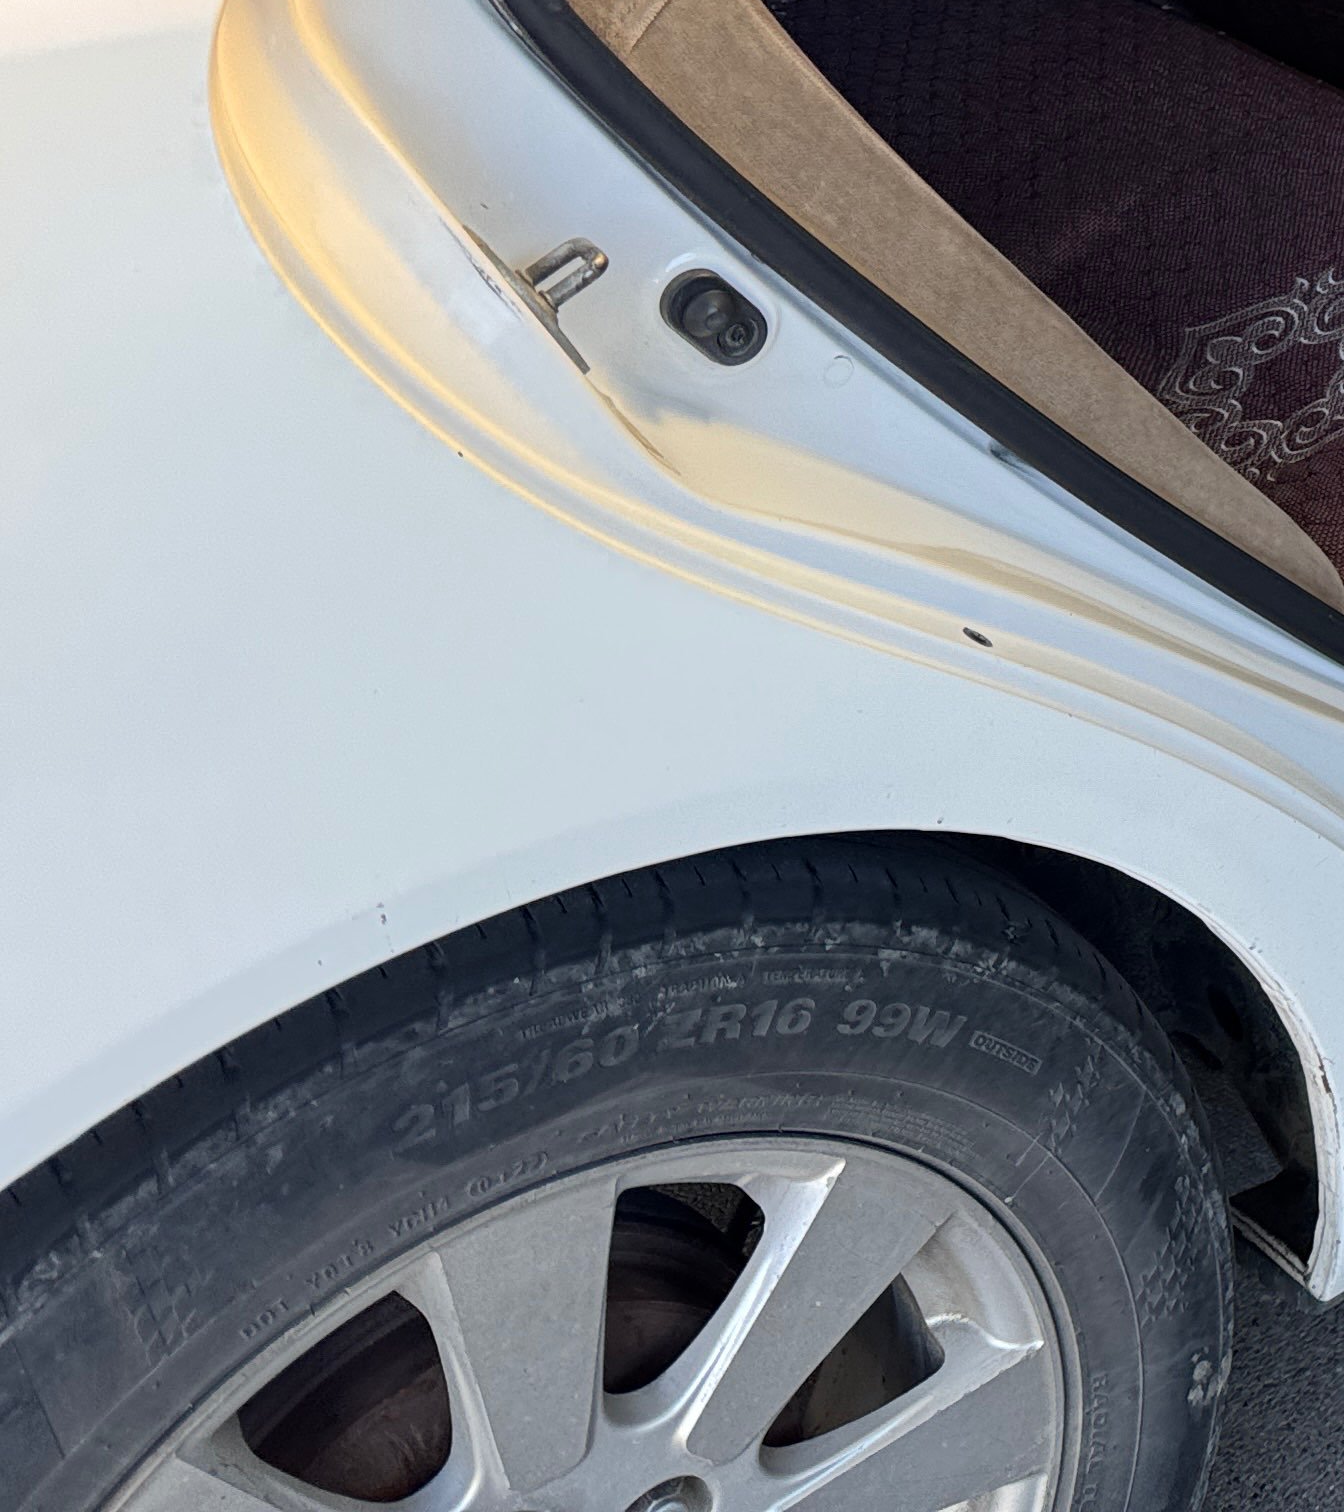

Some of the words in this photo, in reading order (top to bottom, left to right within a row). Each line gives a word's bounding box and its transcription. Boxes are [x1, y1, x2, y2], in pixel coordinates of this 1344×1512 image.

[391, 1023, 641, 1156] 215/60
[657, 997, 816, 1051] ZR16
[836, 998, 968, 1048] 99W
[973, 1033, 1040, 1073] OUTSIDE
